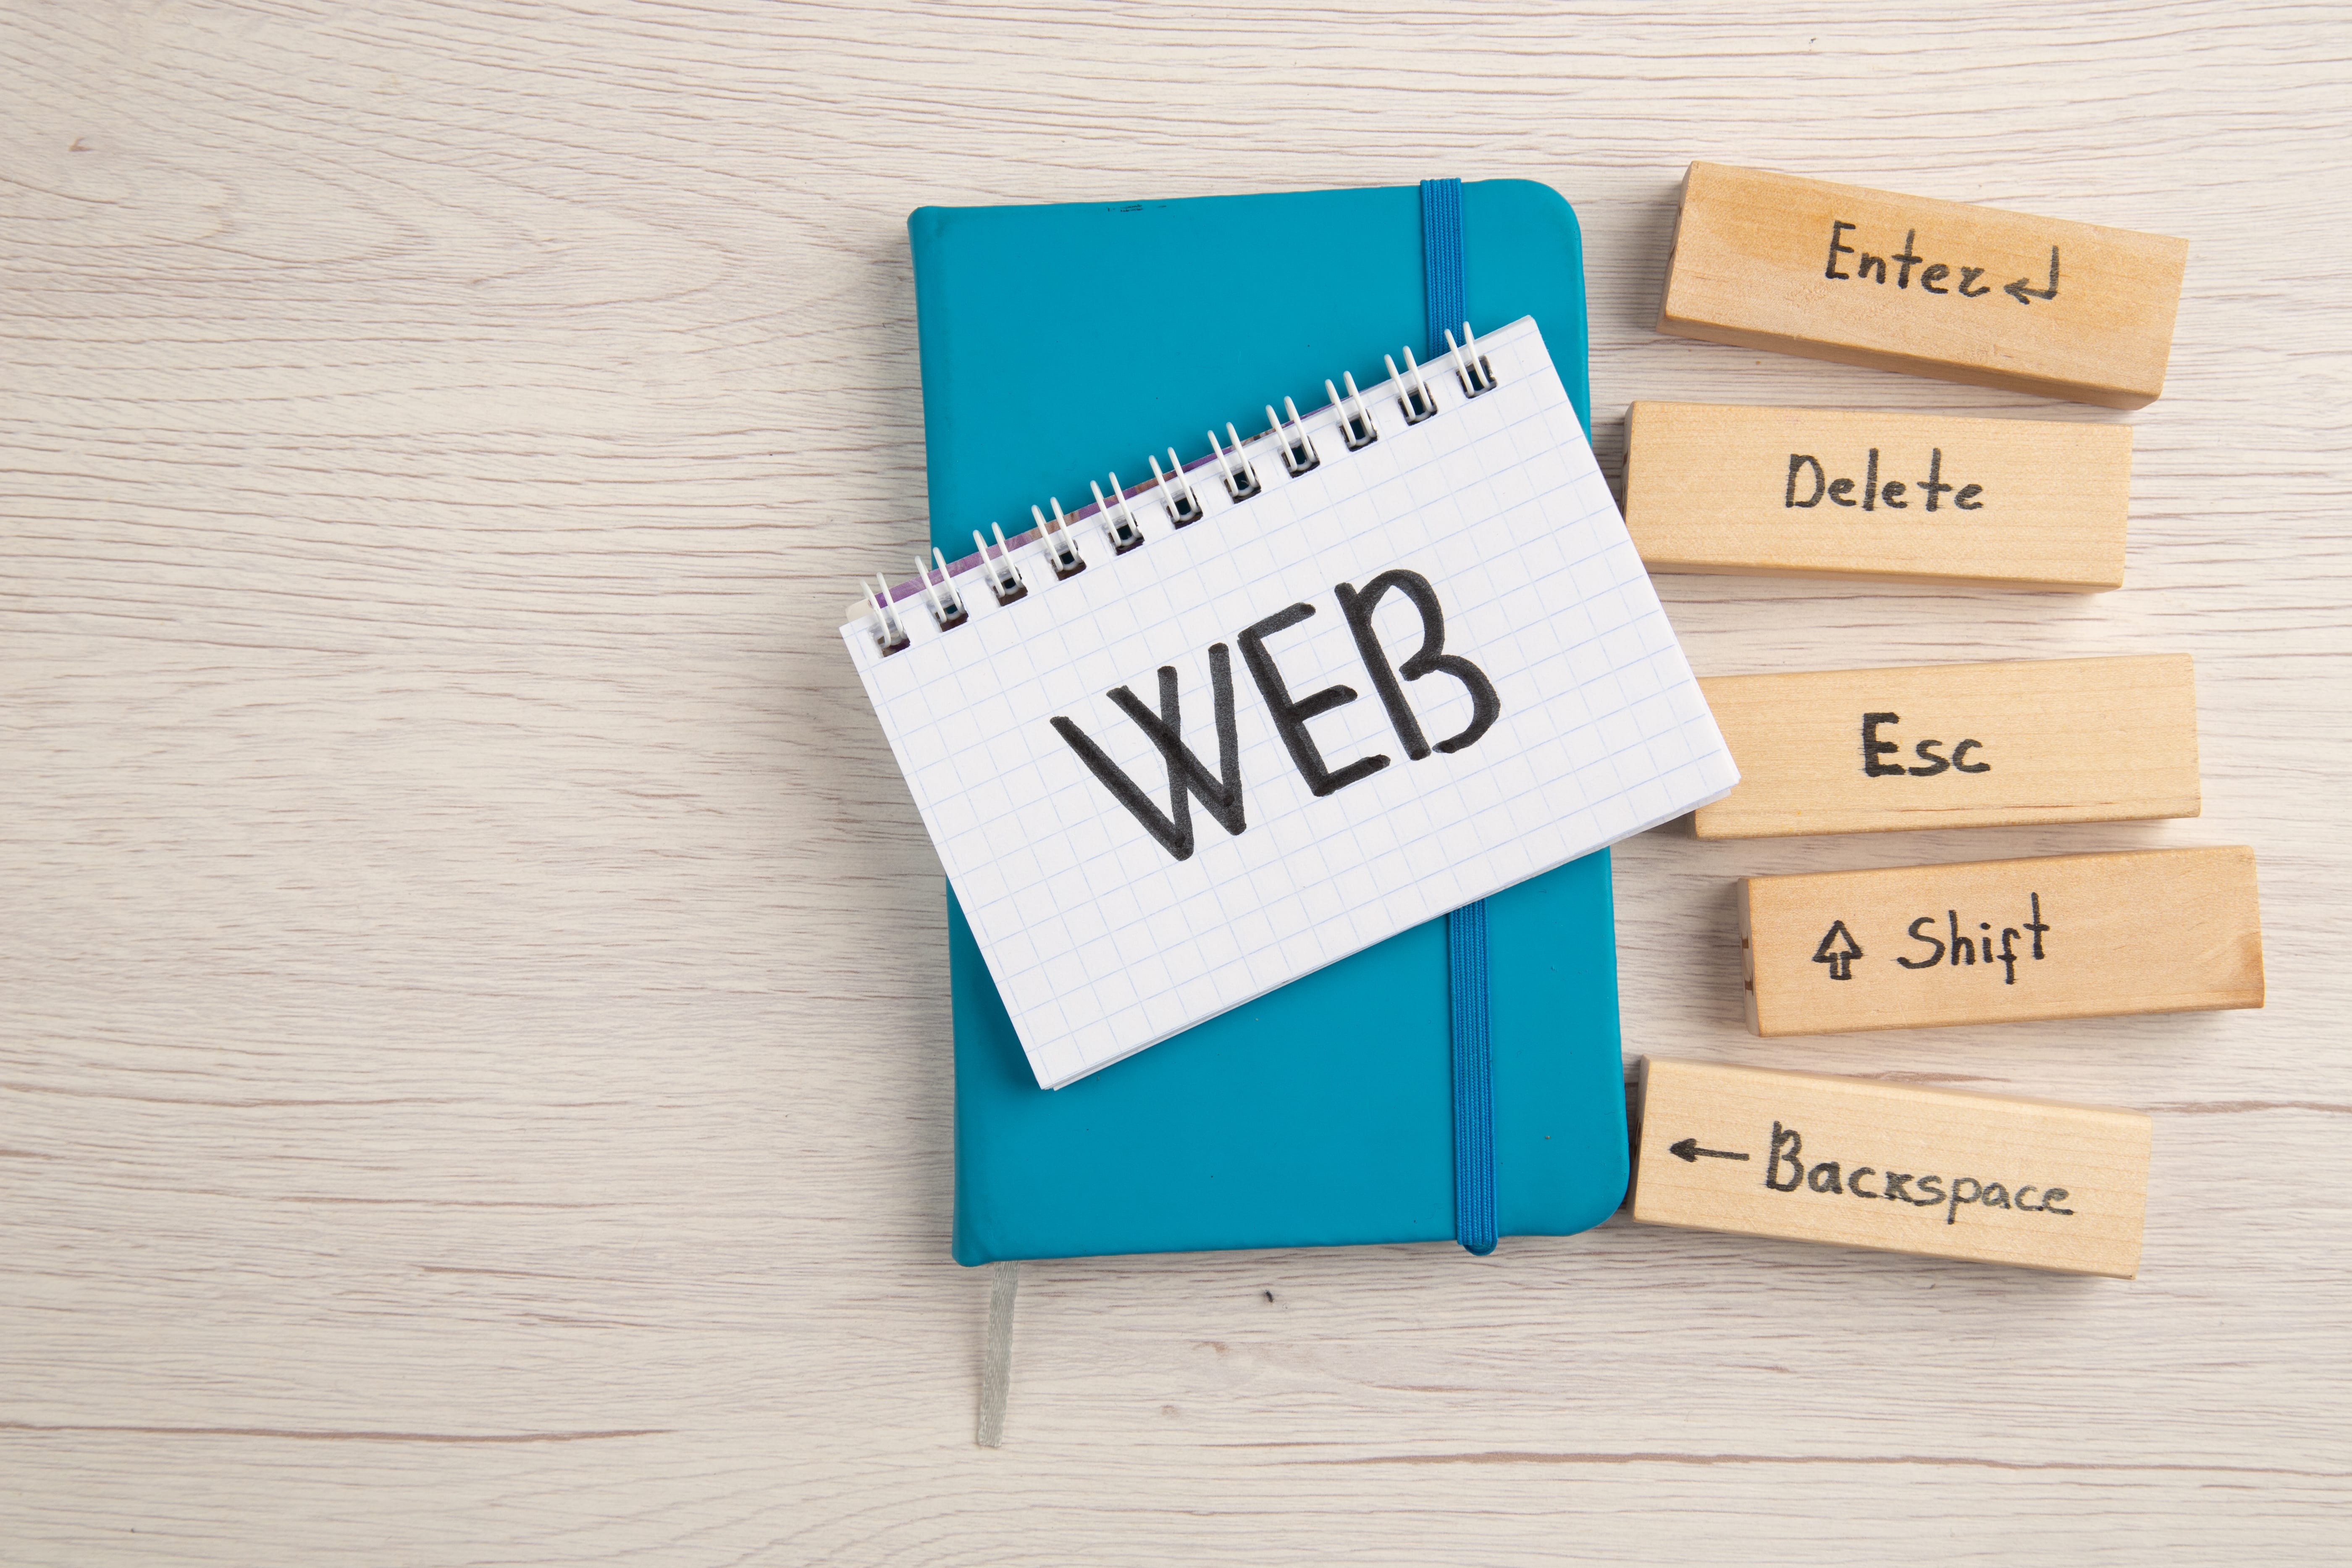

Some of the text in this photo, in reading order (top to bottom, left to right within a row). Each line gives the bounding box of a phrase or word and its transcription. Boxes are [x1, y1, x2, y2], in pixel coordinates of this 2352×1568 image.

[1825, 221, 1991, 297] Enter
[1785, 448, 1984, 512] Delete
[1050, 569, 1501, 861] WEB
[1862, 712, 1991, 777] Esc
[1896, 892, 2050, 985] Shift
[1765, 1121, 2075, 1225] Backspace
